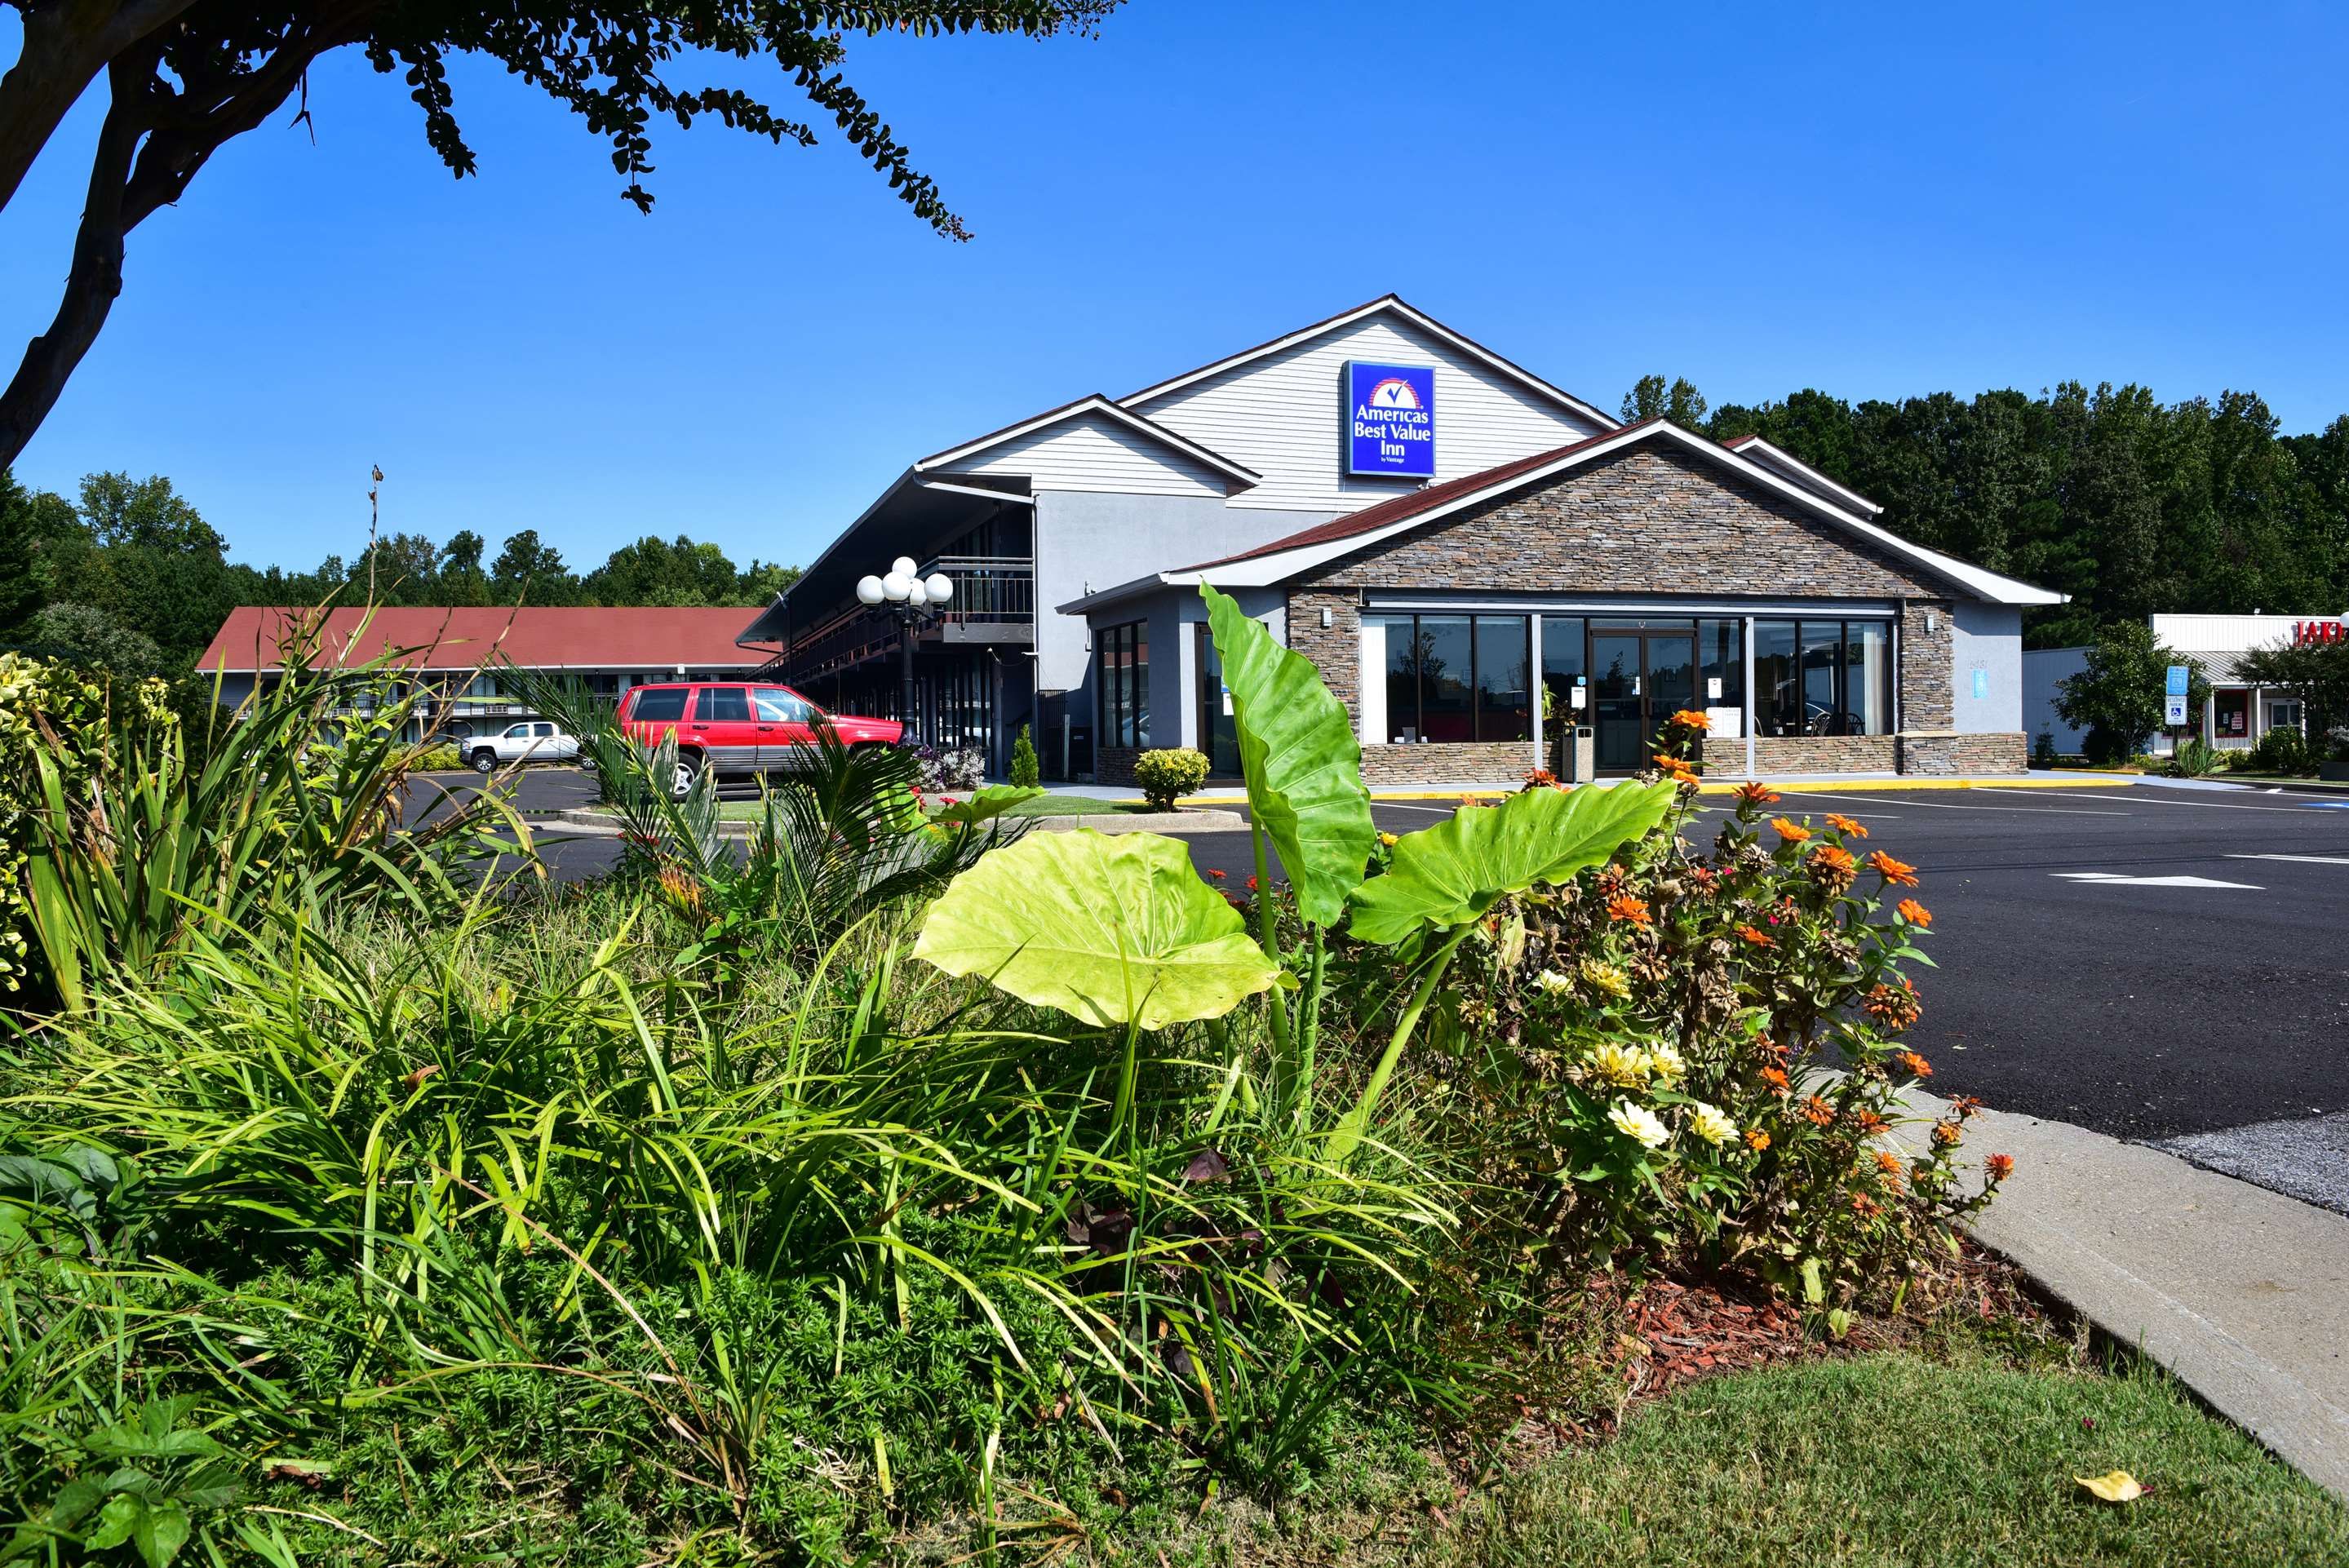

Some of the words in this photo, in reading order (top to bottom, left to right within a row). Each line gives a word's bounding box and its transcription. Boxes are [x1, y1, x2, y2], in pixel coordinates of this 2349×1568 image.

[1356, 404, 1429, 423] Americas
[1354, 422, 1387, 439] Best
[1390, 423, 1431, 441] Value
[1381, 440, 1405, 456] Inn
